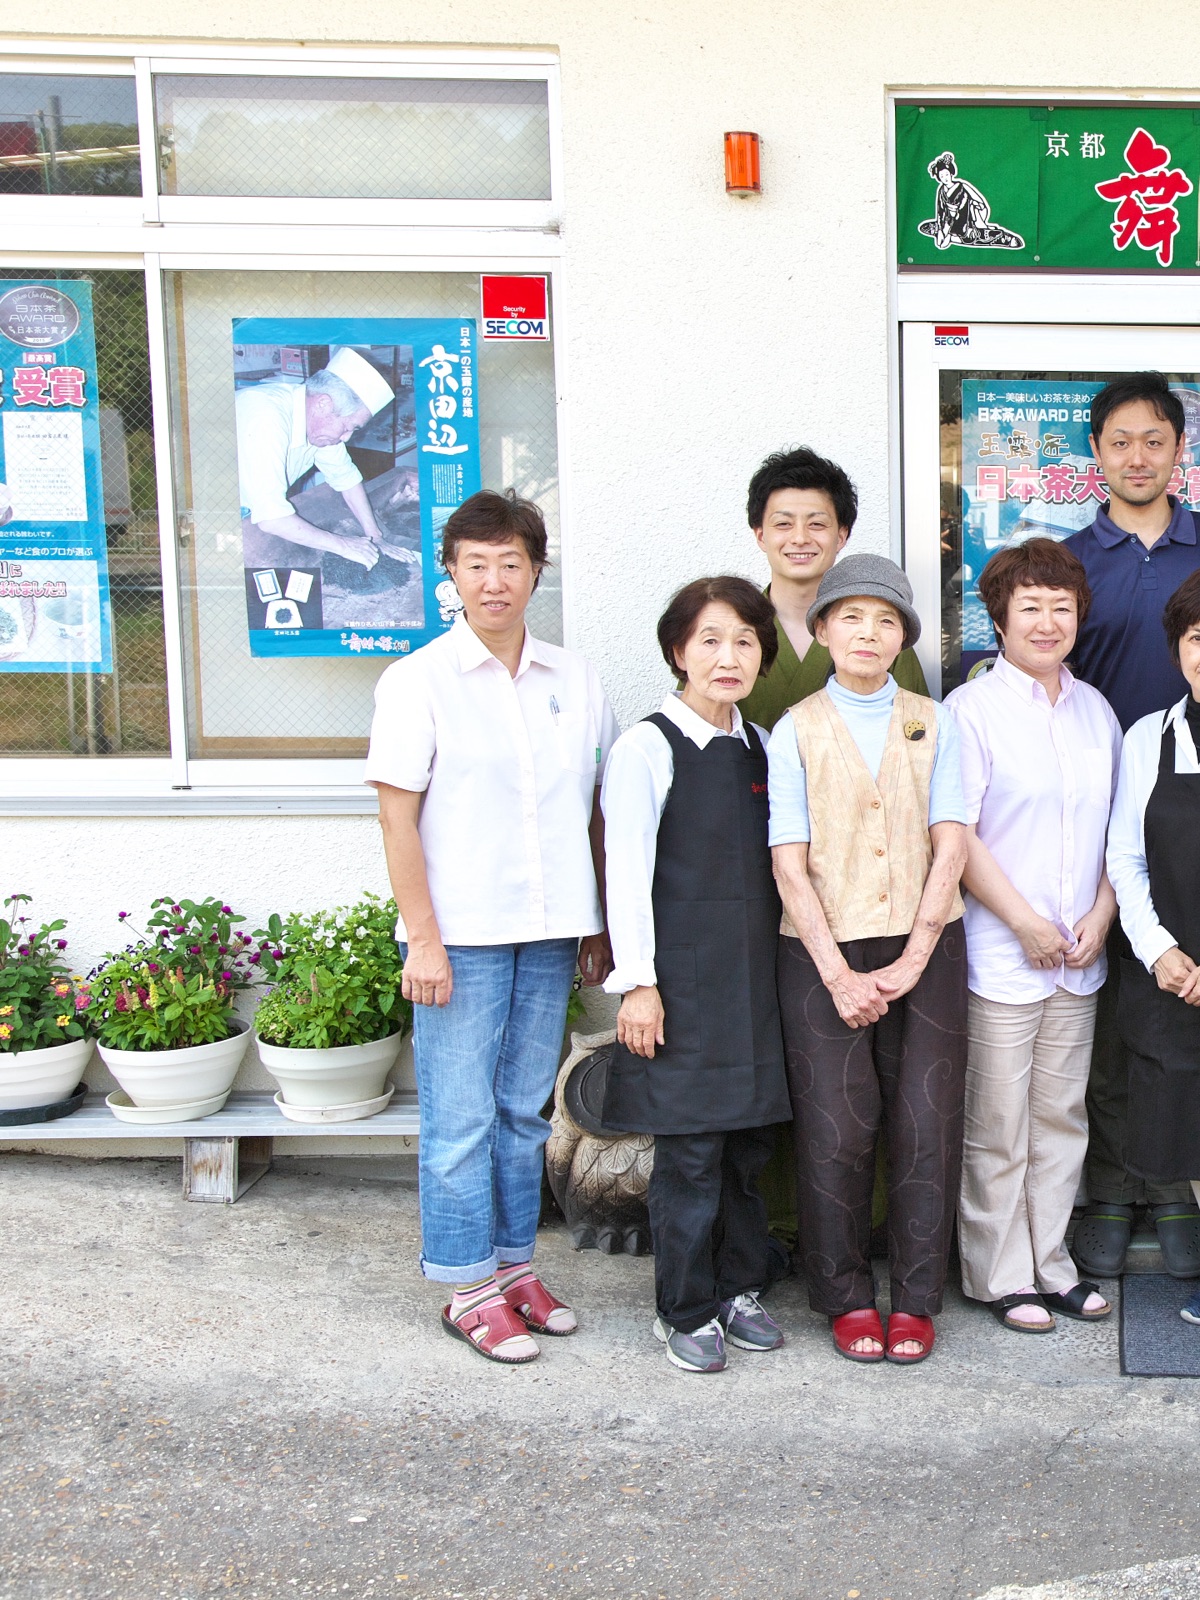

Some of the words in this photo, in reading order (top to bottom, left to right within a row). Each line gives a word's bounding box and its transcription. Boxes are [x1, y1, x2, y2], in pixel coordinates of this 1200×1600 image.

[1044, 131, 1106, 160] 京都
[15, 304, 57, 313] 日本茶
[503, 305, 526, 313] Security
[9, 314, 65, 322] AWARD
[17, 326, 59, 334] 日本茶大賞
[486, 320, 543, 335] SECOM
[934, 336, 970, 346] SECOM
[460, 327, 473, 418] 日本一の玉露の産地
[13, 366, 86, 406] 受賞
[418, 344, 469, 456] 京田辺
[978, 407, 1068, 422] 日本茶AWARD
